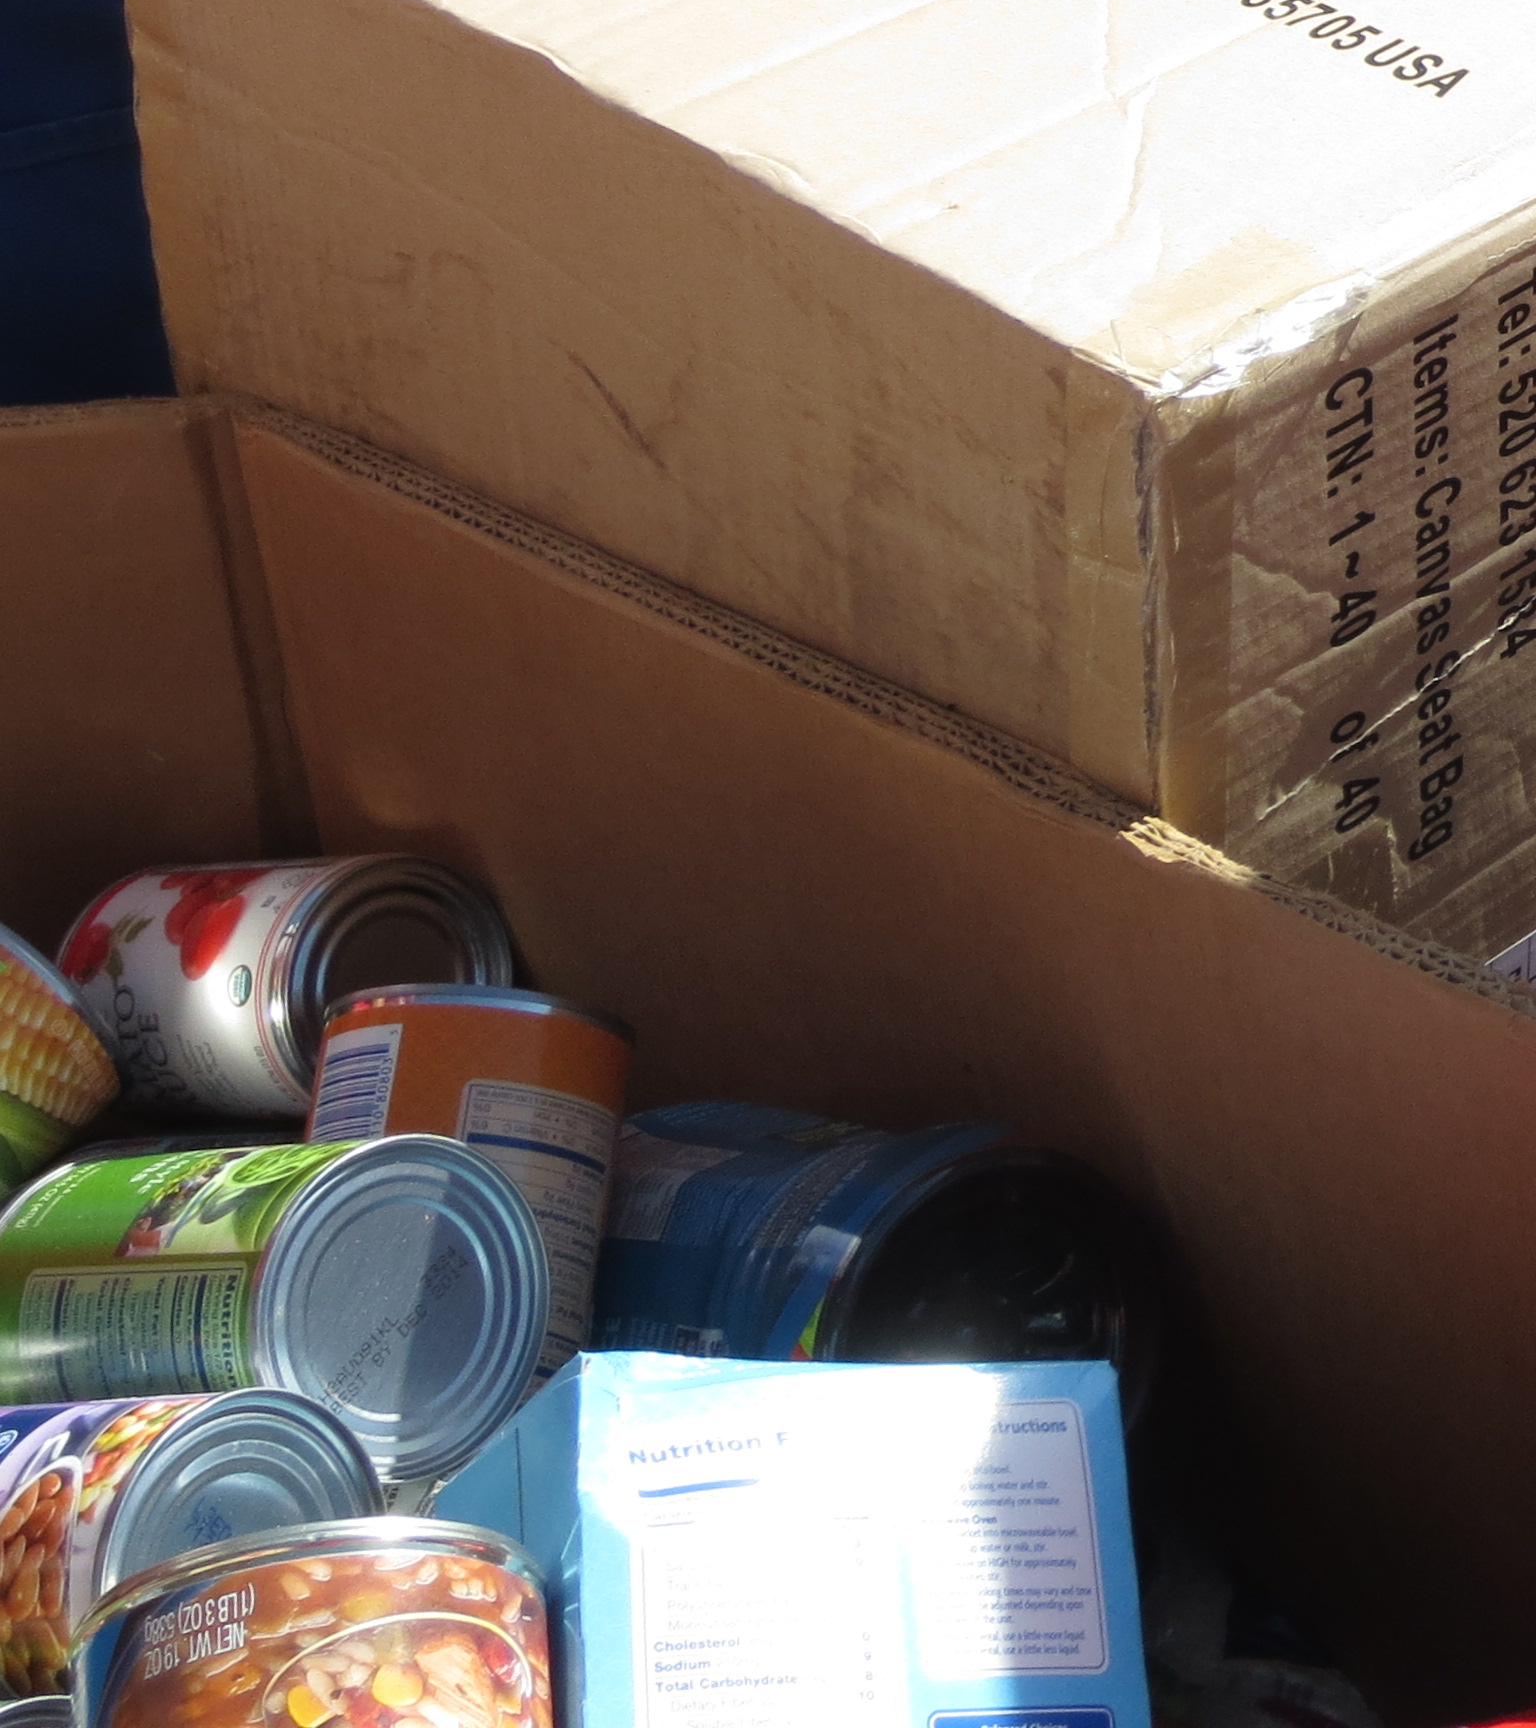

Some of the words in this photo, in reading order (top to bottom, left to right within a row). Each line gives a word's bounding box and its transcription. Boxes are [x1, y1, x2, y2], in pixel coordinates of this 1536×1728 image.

[1365, 36, 1471, 98] USA
[1412, 312, 1459, 478] Items:
[1325, 366, 1375, 499] CTN:
[1412, 475, 1461, 655] Canvas
[1413, 649, 1463, 769] Seat
[1330, 710, 1379, 764] of
[1333, 775, 1381, 836] 40
[1407, 755, 1466, 862] Bag
[222, 1273, 239, 1389] Nutrition
[628, 1436, 762, 1465] Nutrition
[144, 1611, 176, 1646] 538g
[177, 1601, 203, 1635] OZ)
[183, 1629, 212, 1664] WT.
[213, 1620, 248, 1655] NET
[653, 1636, 741, 1653] Cholesterol
[143, 1647, 162, 1681] OZ
[163, 1641, 181, 1671] 19
[653, 1659, 712, 1674] Sodium
[655, 1679, 694, 1693] Total
[699, 1673, 798, 1690] Carbohydrate
